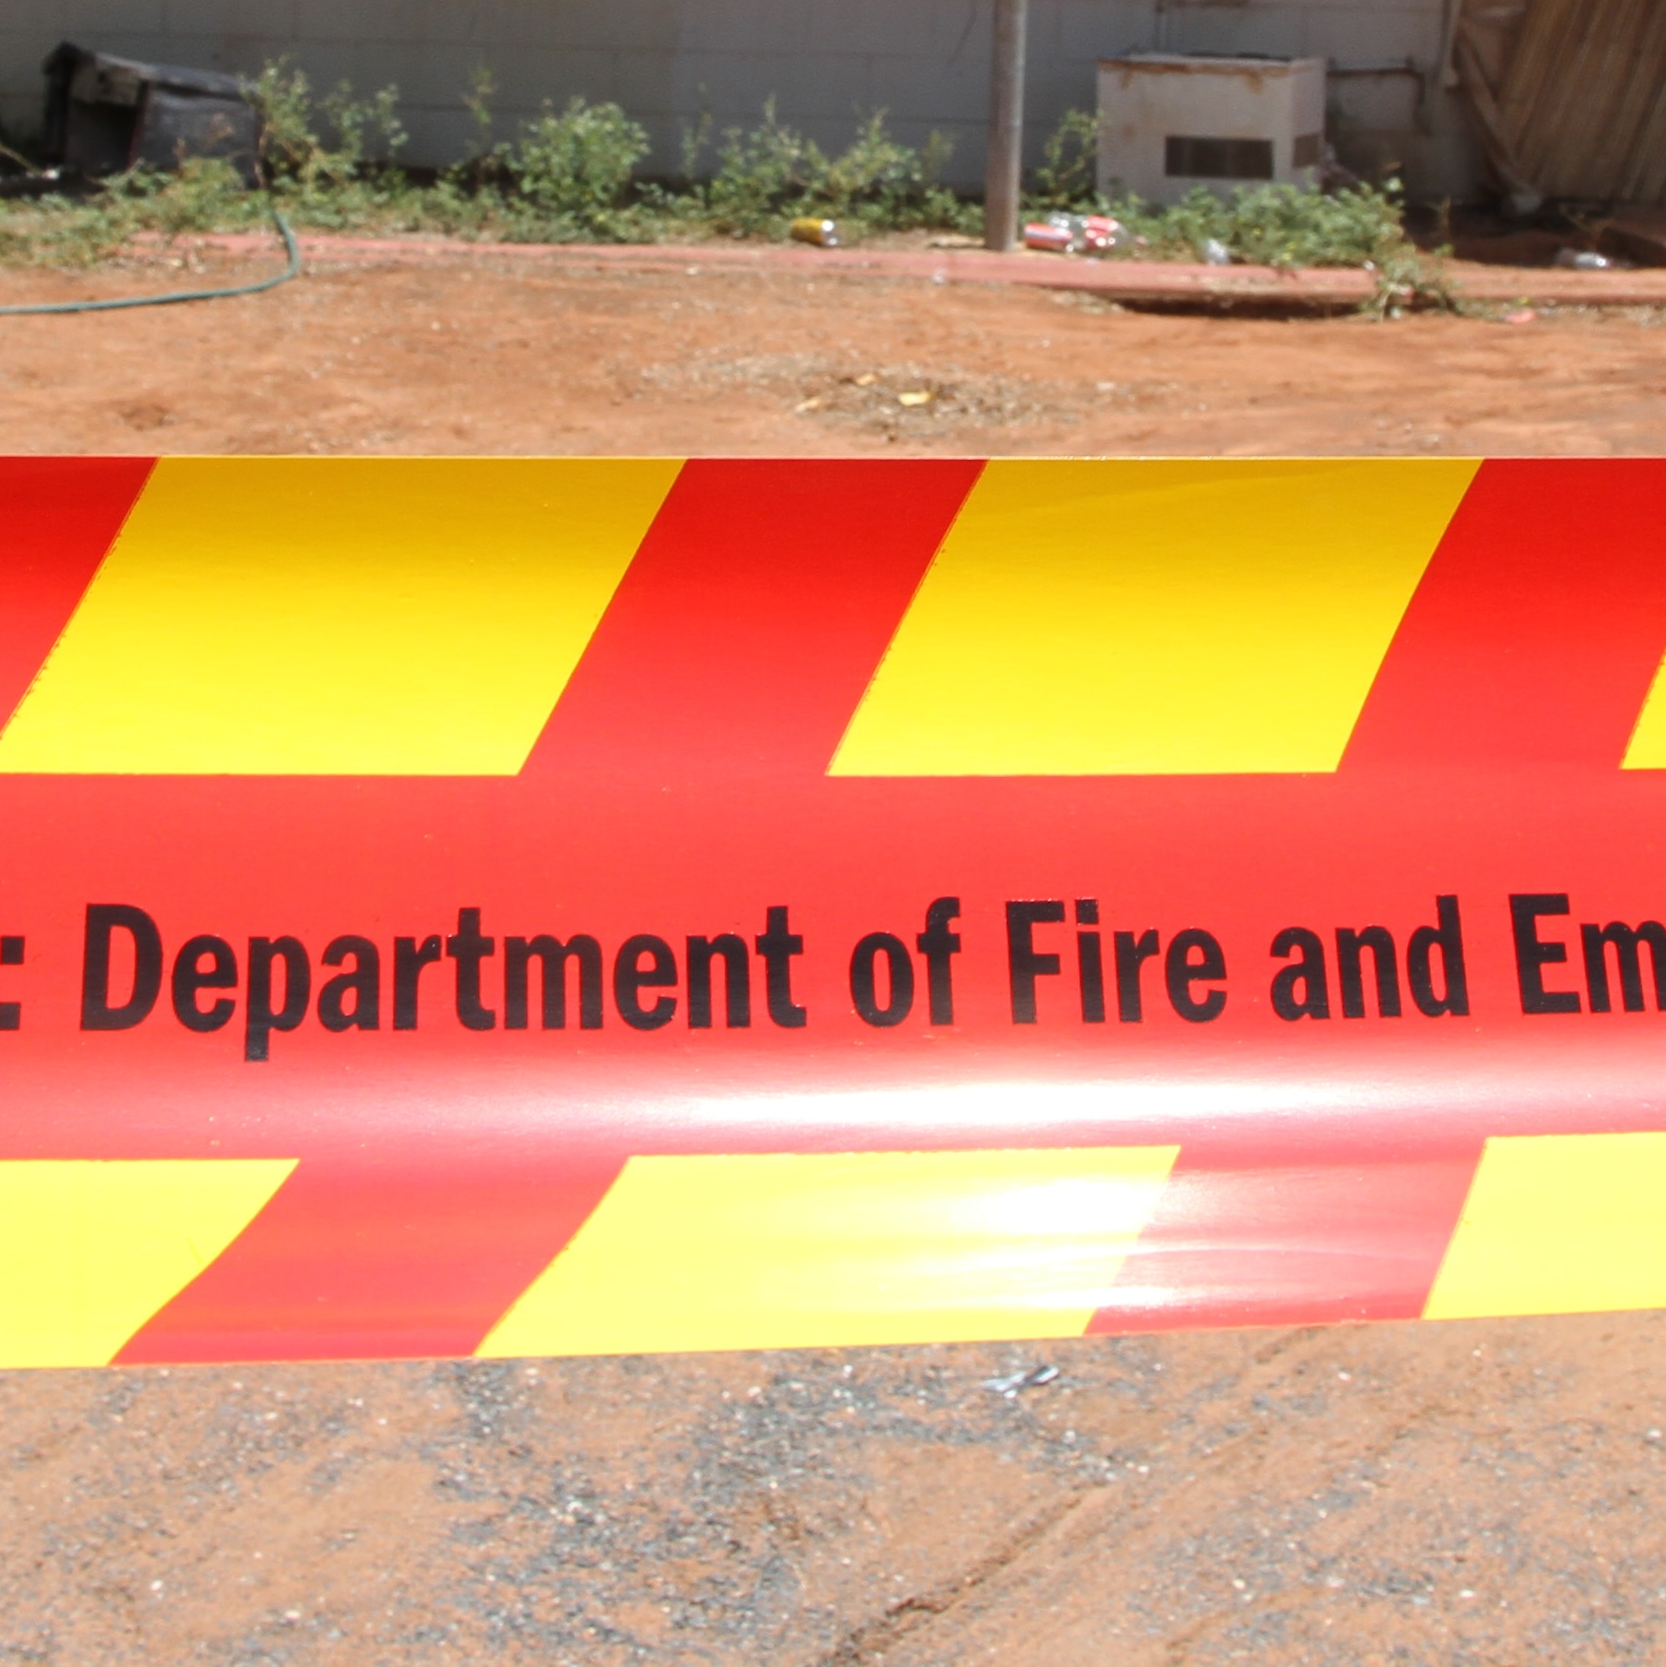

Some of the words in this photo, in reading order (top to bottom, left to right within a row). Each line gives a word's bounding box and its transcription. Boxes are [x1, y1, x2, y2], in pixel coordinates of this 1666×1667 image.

[81, 903, 806, 1062] Department
[850, 896, 963, 1028] of
[1006, 894, 1227, 1024] Fire
[1271, 894, 1470, 1022] and
